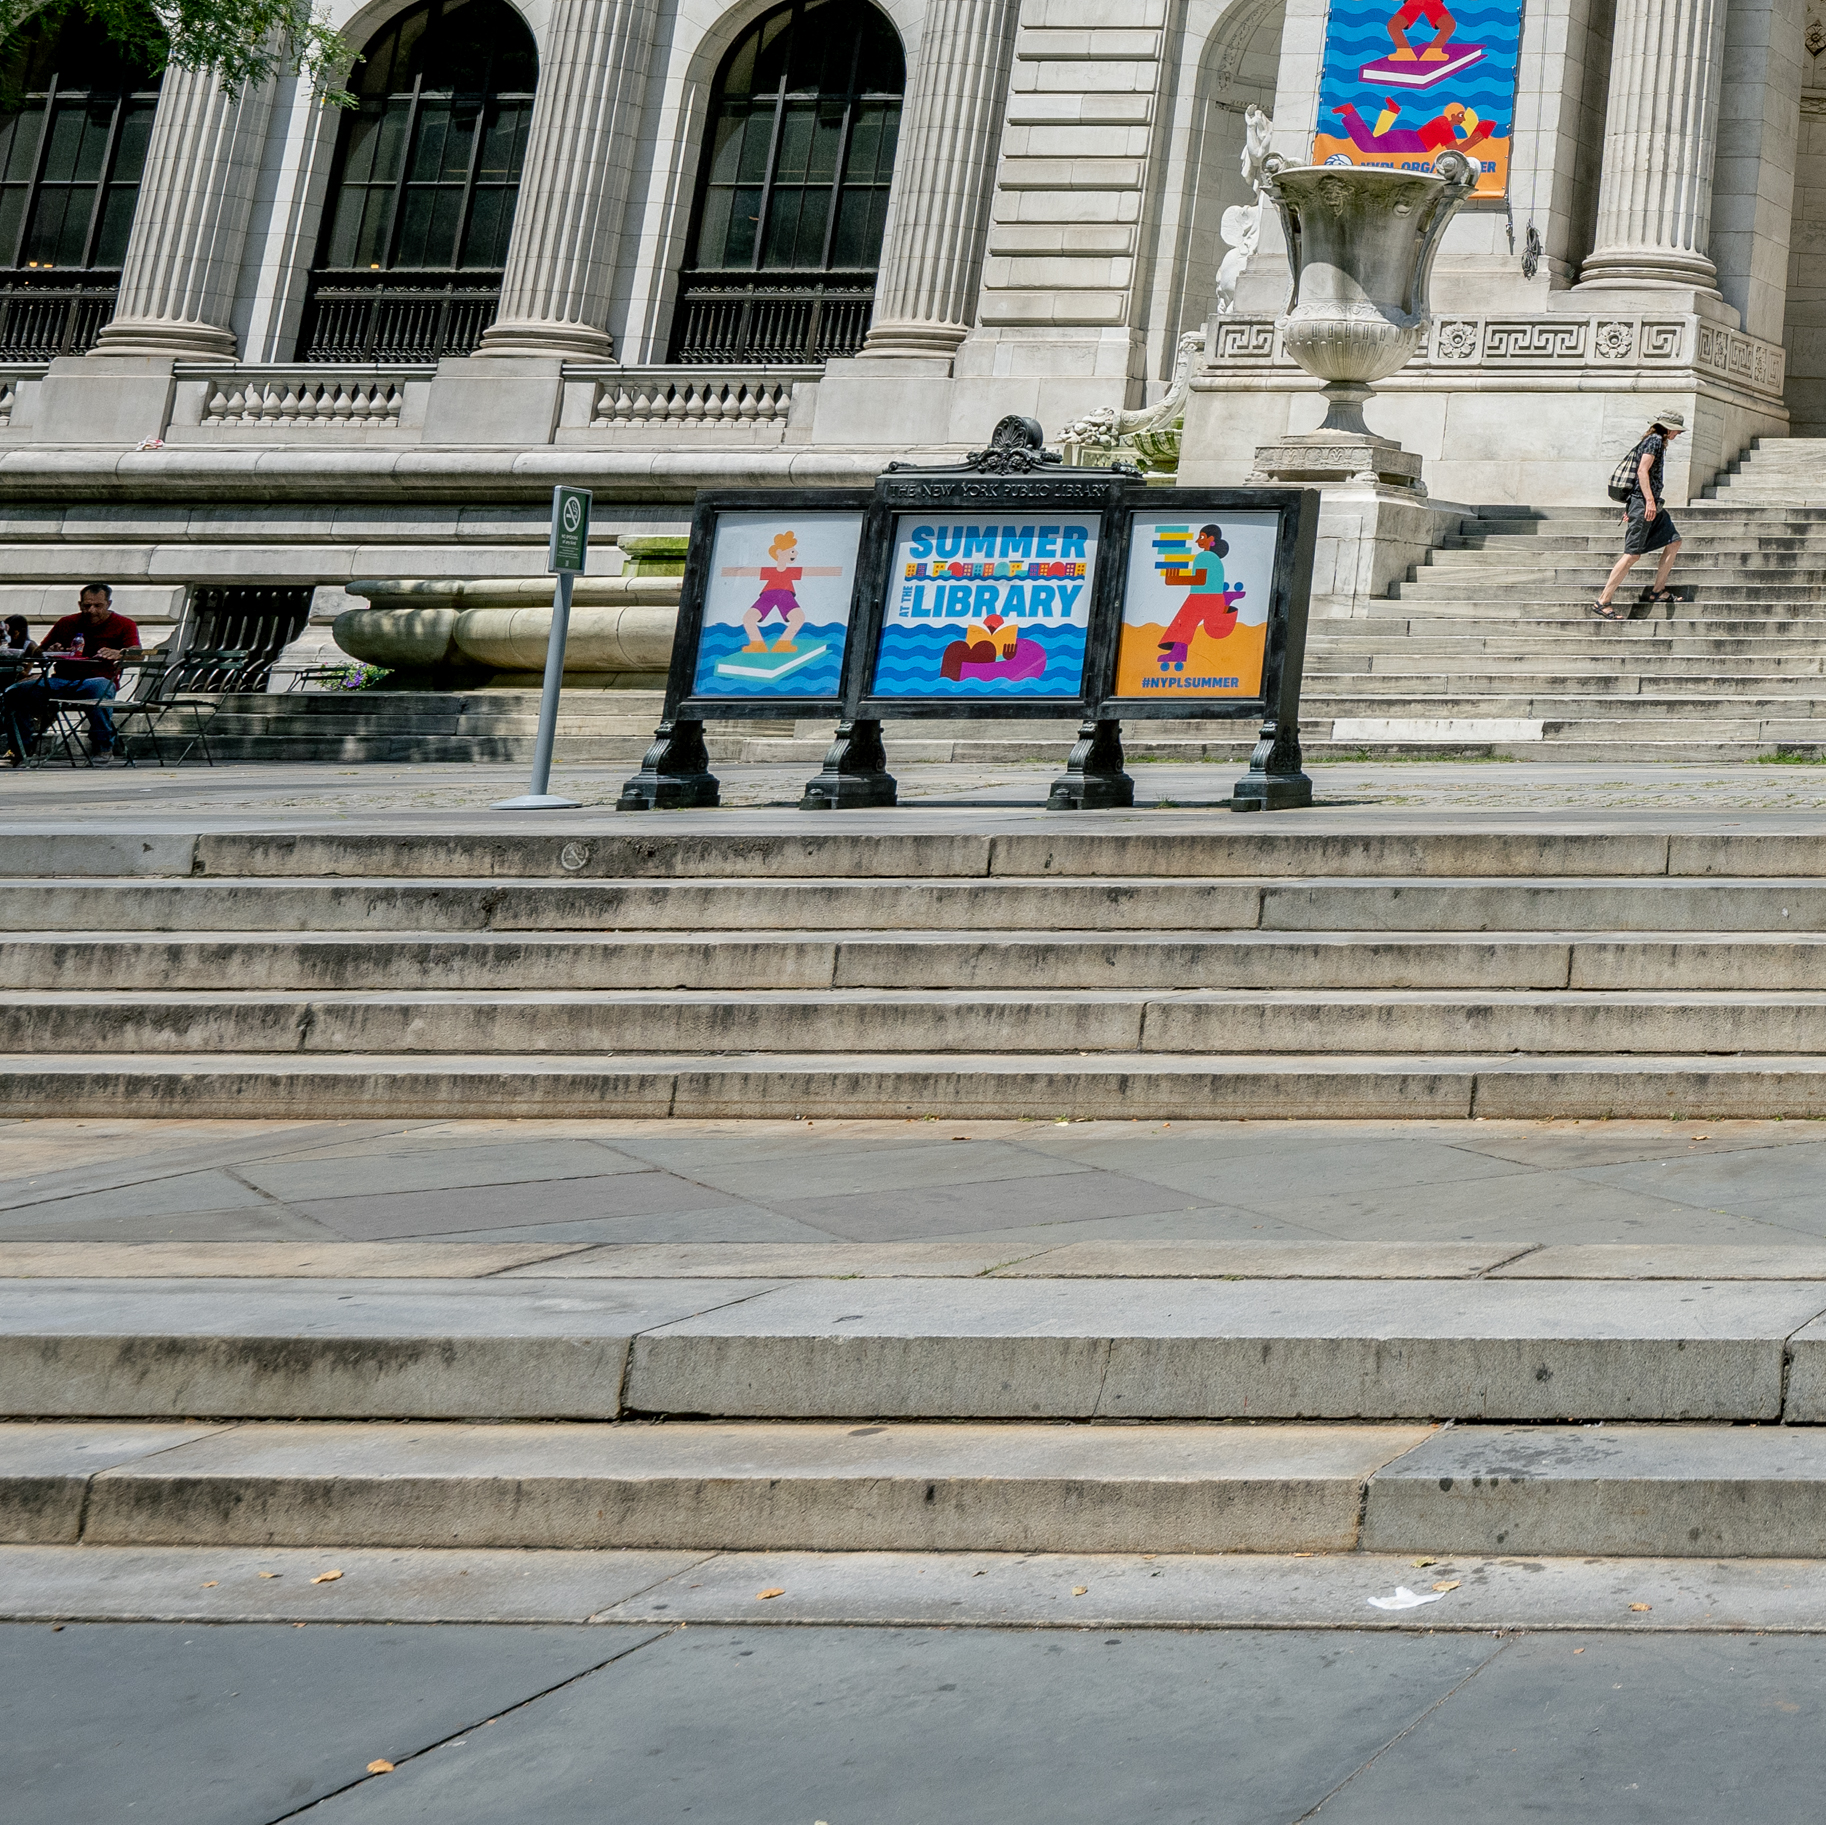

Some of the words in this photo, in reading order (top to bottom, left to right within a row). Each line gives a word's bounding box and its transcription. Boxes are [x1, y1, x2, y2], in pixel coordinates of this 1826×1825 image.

[889, 484, 916, 498] THE
[922, 484, 955, 498] NEW
[961, 484, 1000, 498] YORK
[1003, 484, 1050, 498] PUBLIC
[1054, 484, 1110, 498] LIBRARY
[909, 525, 1089, 559] SUMMER
[901, 585, 914, 603] THE
[911, 585, 1083, 618] LIBRARY
[899, 606, 910, 617] AT
[1142, 677, 1239, 688] #NYPLSUMMER
